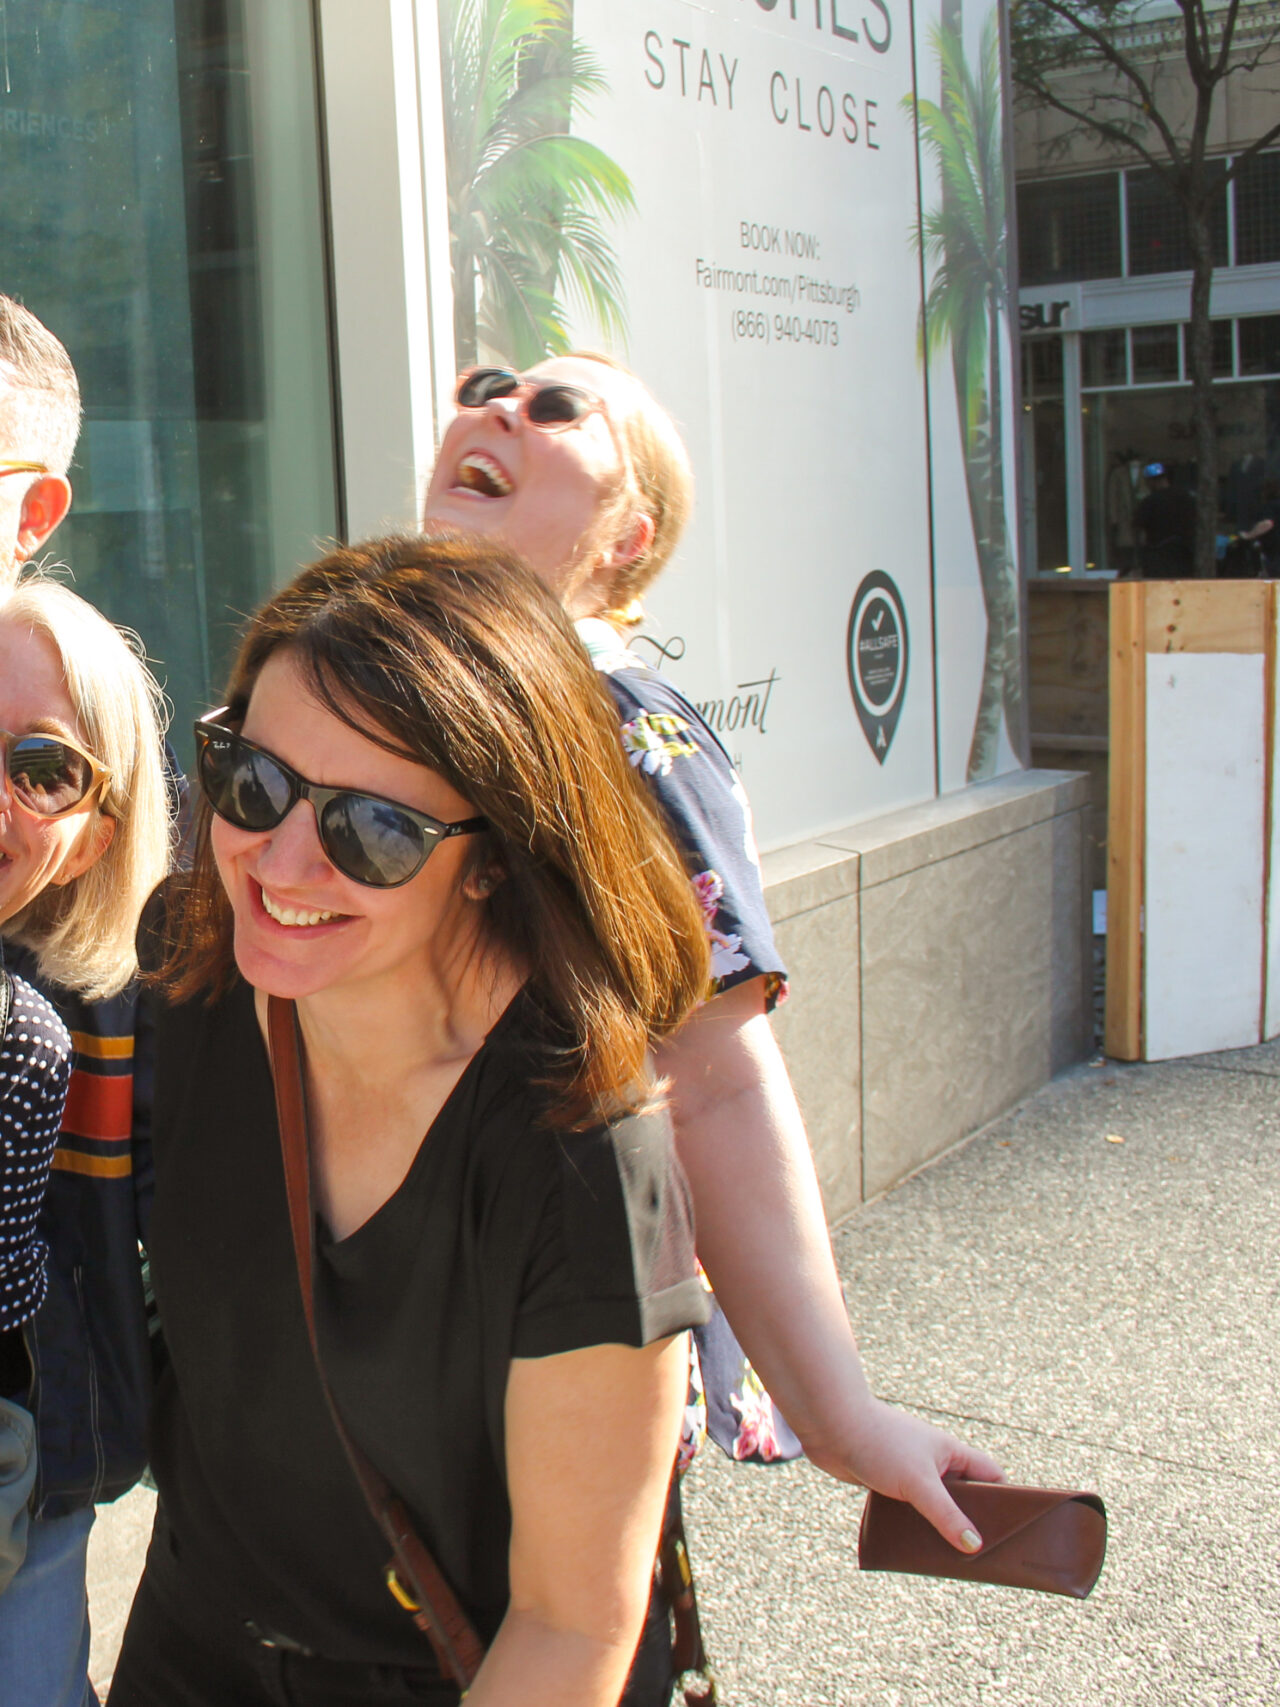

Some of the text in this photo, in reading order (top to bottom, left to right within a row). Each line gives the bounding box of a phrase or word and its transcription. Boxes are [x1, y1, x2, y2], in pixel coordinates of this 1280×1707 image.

[644, 29, 880, 150] STAY CLOSE
[740, 221, 820, 261] BOOK NOW:
[695, 258, 861, 313] Fairmont.com/Pittsburgh
[732, 310, 839, 347] (866) 940-4073
